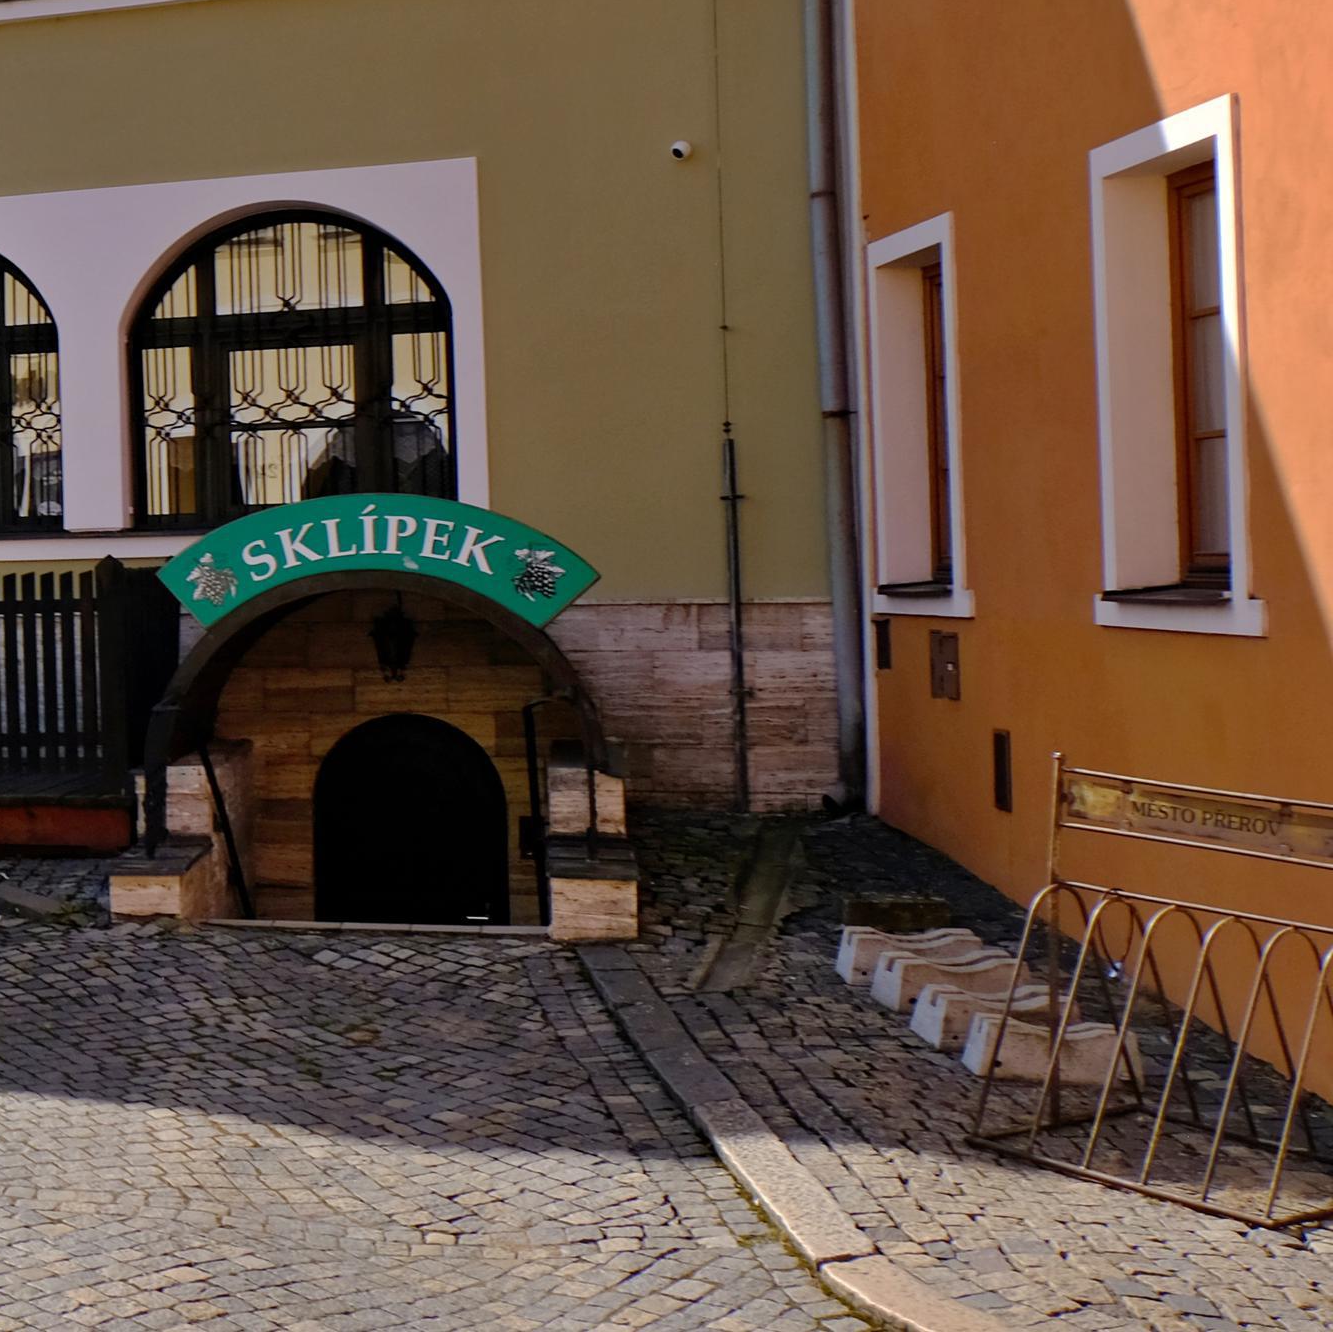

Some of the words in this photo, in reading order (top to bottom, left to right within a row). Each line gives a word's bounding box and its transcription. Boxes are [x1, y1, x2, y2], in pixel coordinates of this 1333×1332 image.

[241, 504, 506, 582] SKLÍPEK
[1132, 798, 1196, 824] MĚSTO
[1201, 809, 1283, 837] PŘEROV
